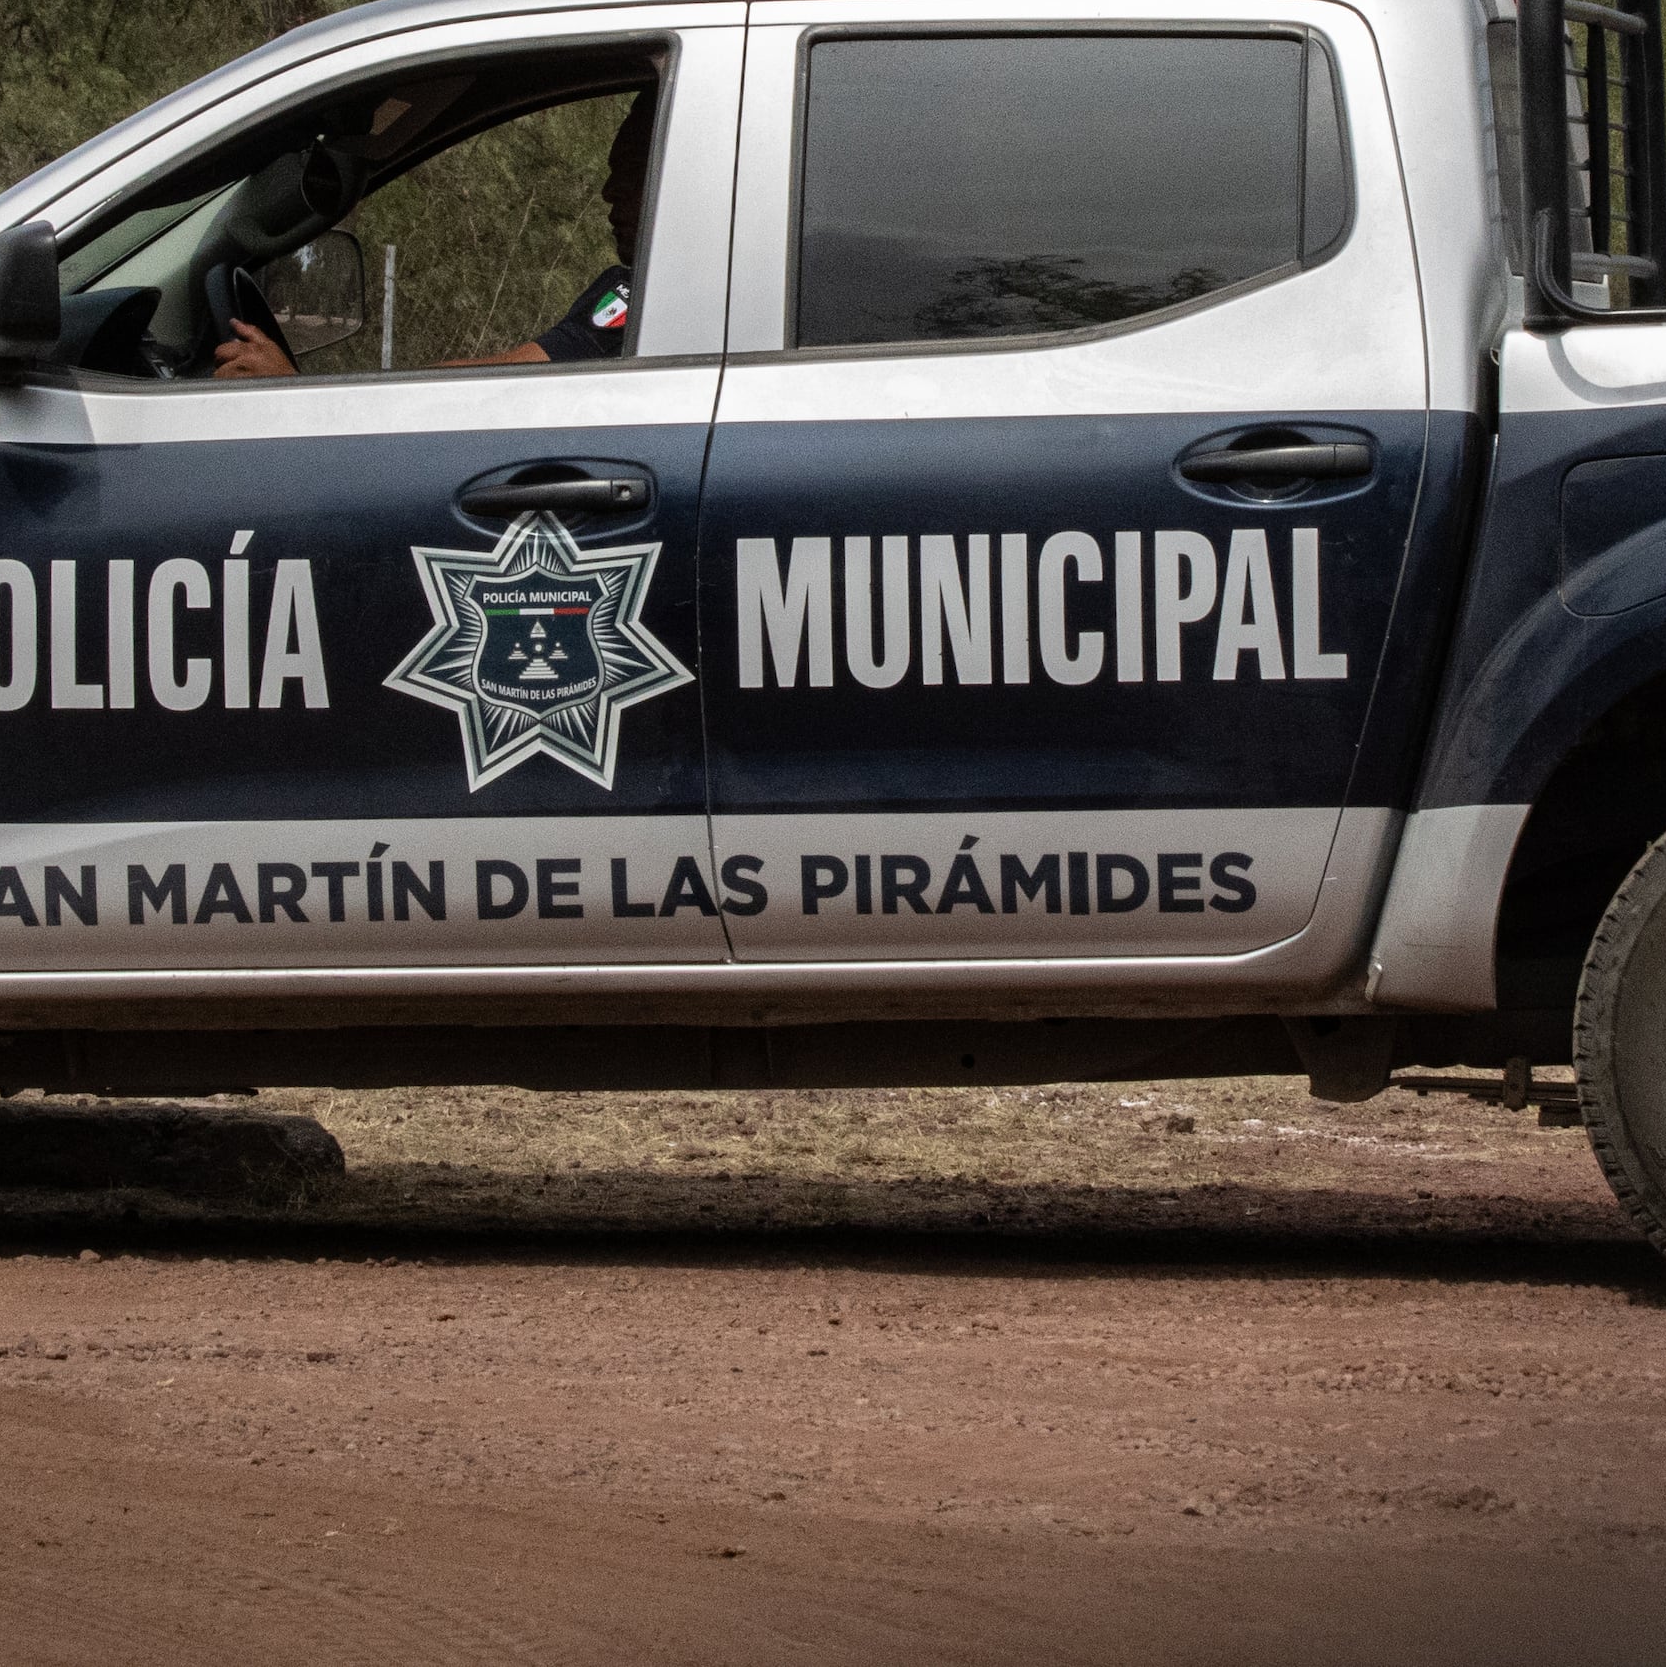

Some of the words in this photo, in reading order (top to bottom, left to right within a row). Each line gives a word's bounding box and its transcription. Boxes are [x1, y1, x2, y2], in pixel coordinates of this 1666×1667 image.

[483, 590, 526, 603] POLICÍA
[530, 591, 592, 603] MUNICIPAL
[736, 528, 1347, 689] MUNICIPAL
[481, 678, 497, 693] SAN
[498, 684, 528, 700] MARTÍN
[530, 690, 541, 700] DE
[542, 689, 556, 700] LAS
[557, 676, 597, 695] PIRÁMIDES
[127, 841, 445, 925] MARTÍN
[476, 858, 585, 920] DE
[614, 853, 767, 918] LAS
[801, 834, 1257, 916] PIRÁMIDES
